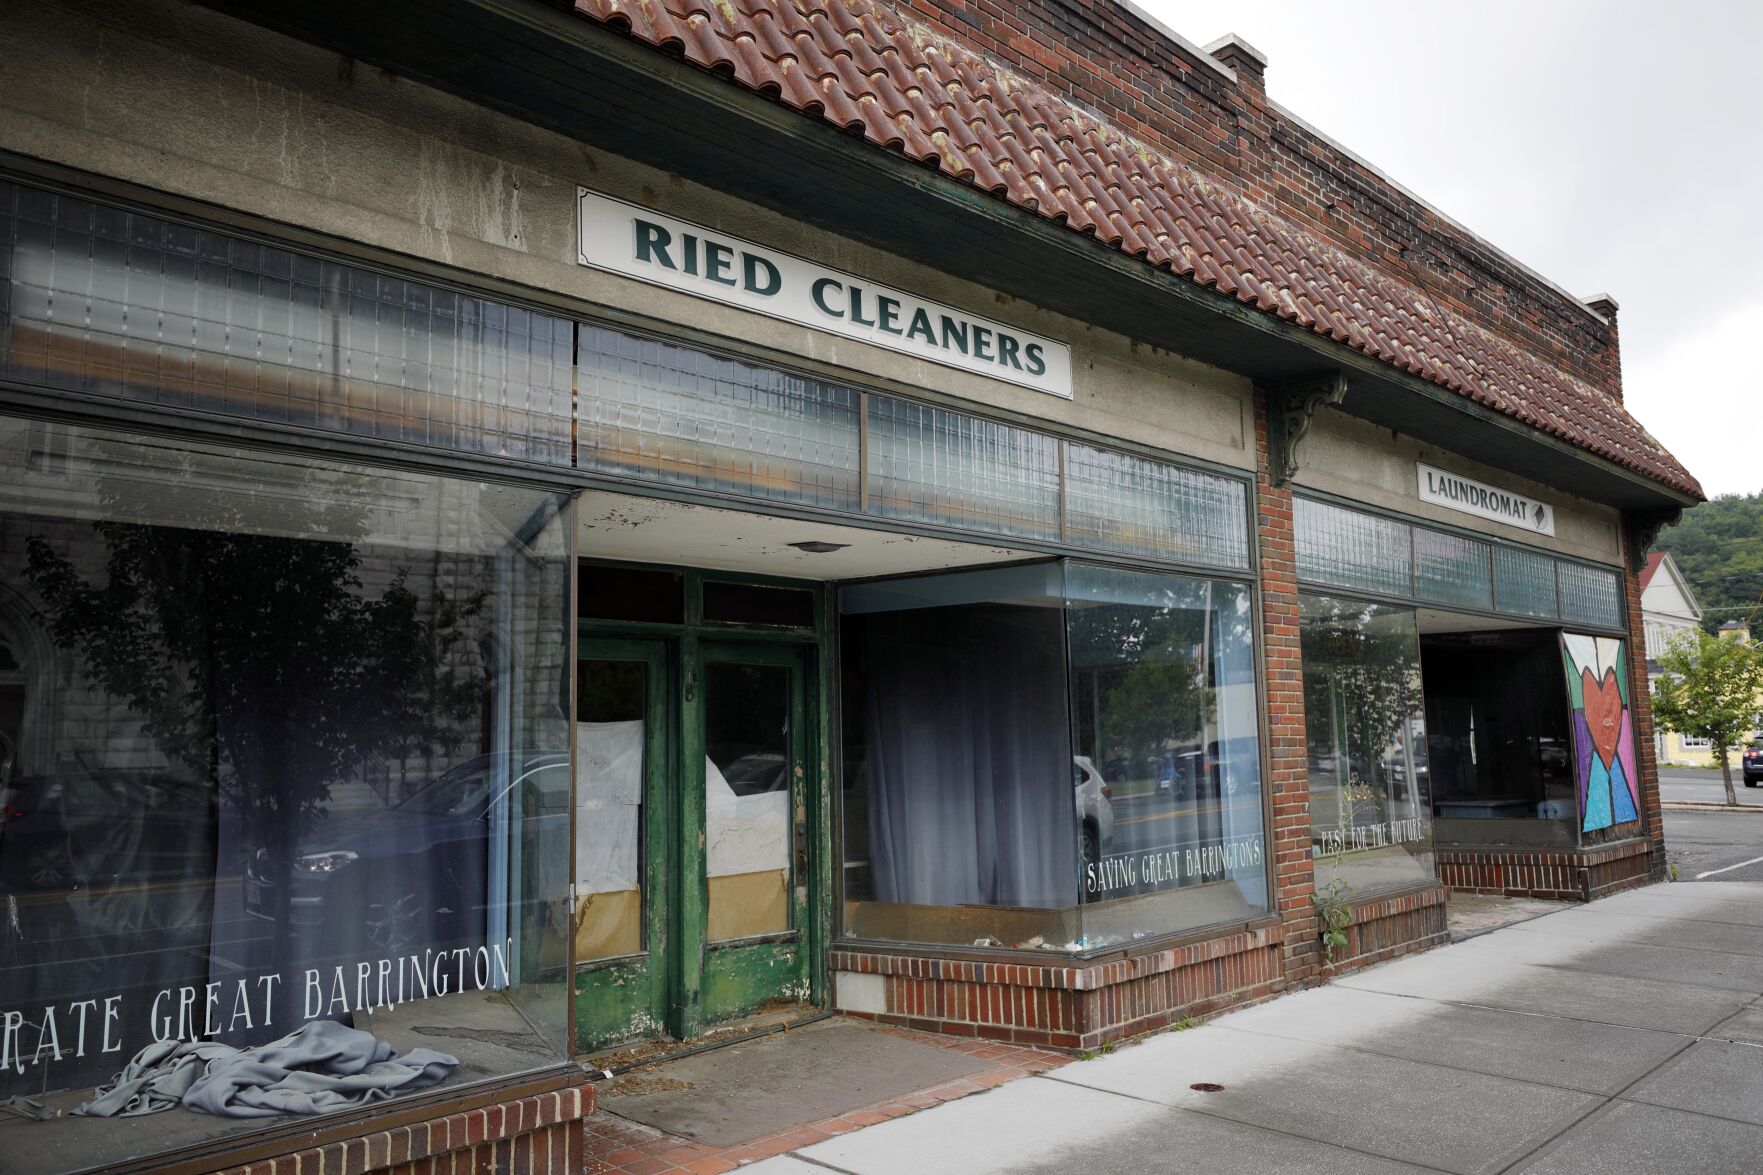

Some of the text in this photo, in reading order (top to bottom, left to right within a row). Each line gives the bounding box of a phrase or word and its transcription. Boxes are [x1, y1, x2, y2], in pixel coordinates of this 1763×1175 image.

[633, 217, 1046, 377] RIED CLEANERS
[1427, 471, 1528, 521] LAUNDROMAT
[1351, 826, 1369, 851] FOR
[1370, 822, 1389, 848] THE
[1087, 855, 1136, 893] SAVING
[1142, 850, 1180, 886] GREAT
[150, 973, 281, 1045] GREAT
[303, 937, 512, 1016] BARRINGTON
